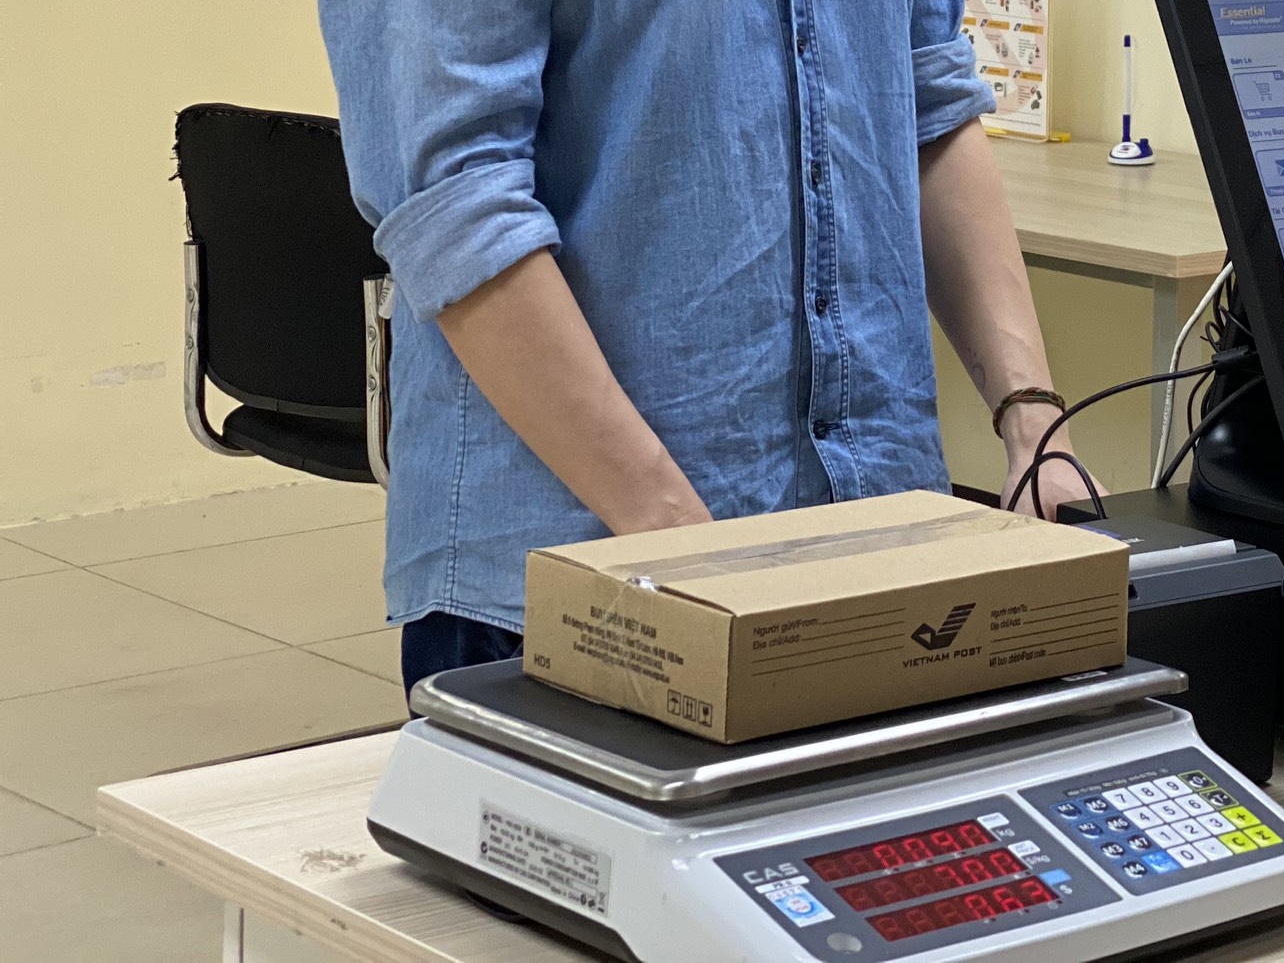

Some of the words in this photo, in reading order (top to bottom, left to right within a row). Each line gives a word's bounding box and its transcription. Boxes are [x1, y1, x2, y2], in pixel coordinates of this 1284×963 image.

[1220, 5, 1266, 18] Essential
[1230, 19, 1253, 27] Powered
[1248, 130, 1262, 139] Dịch
[640, 623, 657, 638] NAM
[902, 652, 950, 668] VIETNAM
[953, 646, 982, 660] POST
[1086, 798, 1105, 811] M5
[1115, 794, 1127, 803] 7
[1141, 787, 1154, 797] 8
[1166, 781, 1179, 791] 9
[1058, 802, 1075, 813] M1
[1108, 817, 1128, 829] M6
[1136, 812, 1150, 822] 4
[1163, 806, 1175, 815] 5
[1188, 799, 1201, 809] 6
[996, 828, 1015, 837] kg
[1079, 822, 1095, 833] M2
[1129, 837, 1148, 850] M7
[1160, 831, 1171, 840] 1
[1185, 825, 1199, 834] 2
[1209, 818, 1223, 828] 3
[1103, 844, 1123, 855] M3
[1124, 863, 1144, 874] M4
[1180, 850, 1194, 860] 0
[1232, 837, 1245, 846] C
[742, 862, 799, 884] CAS
